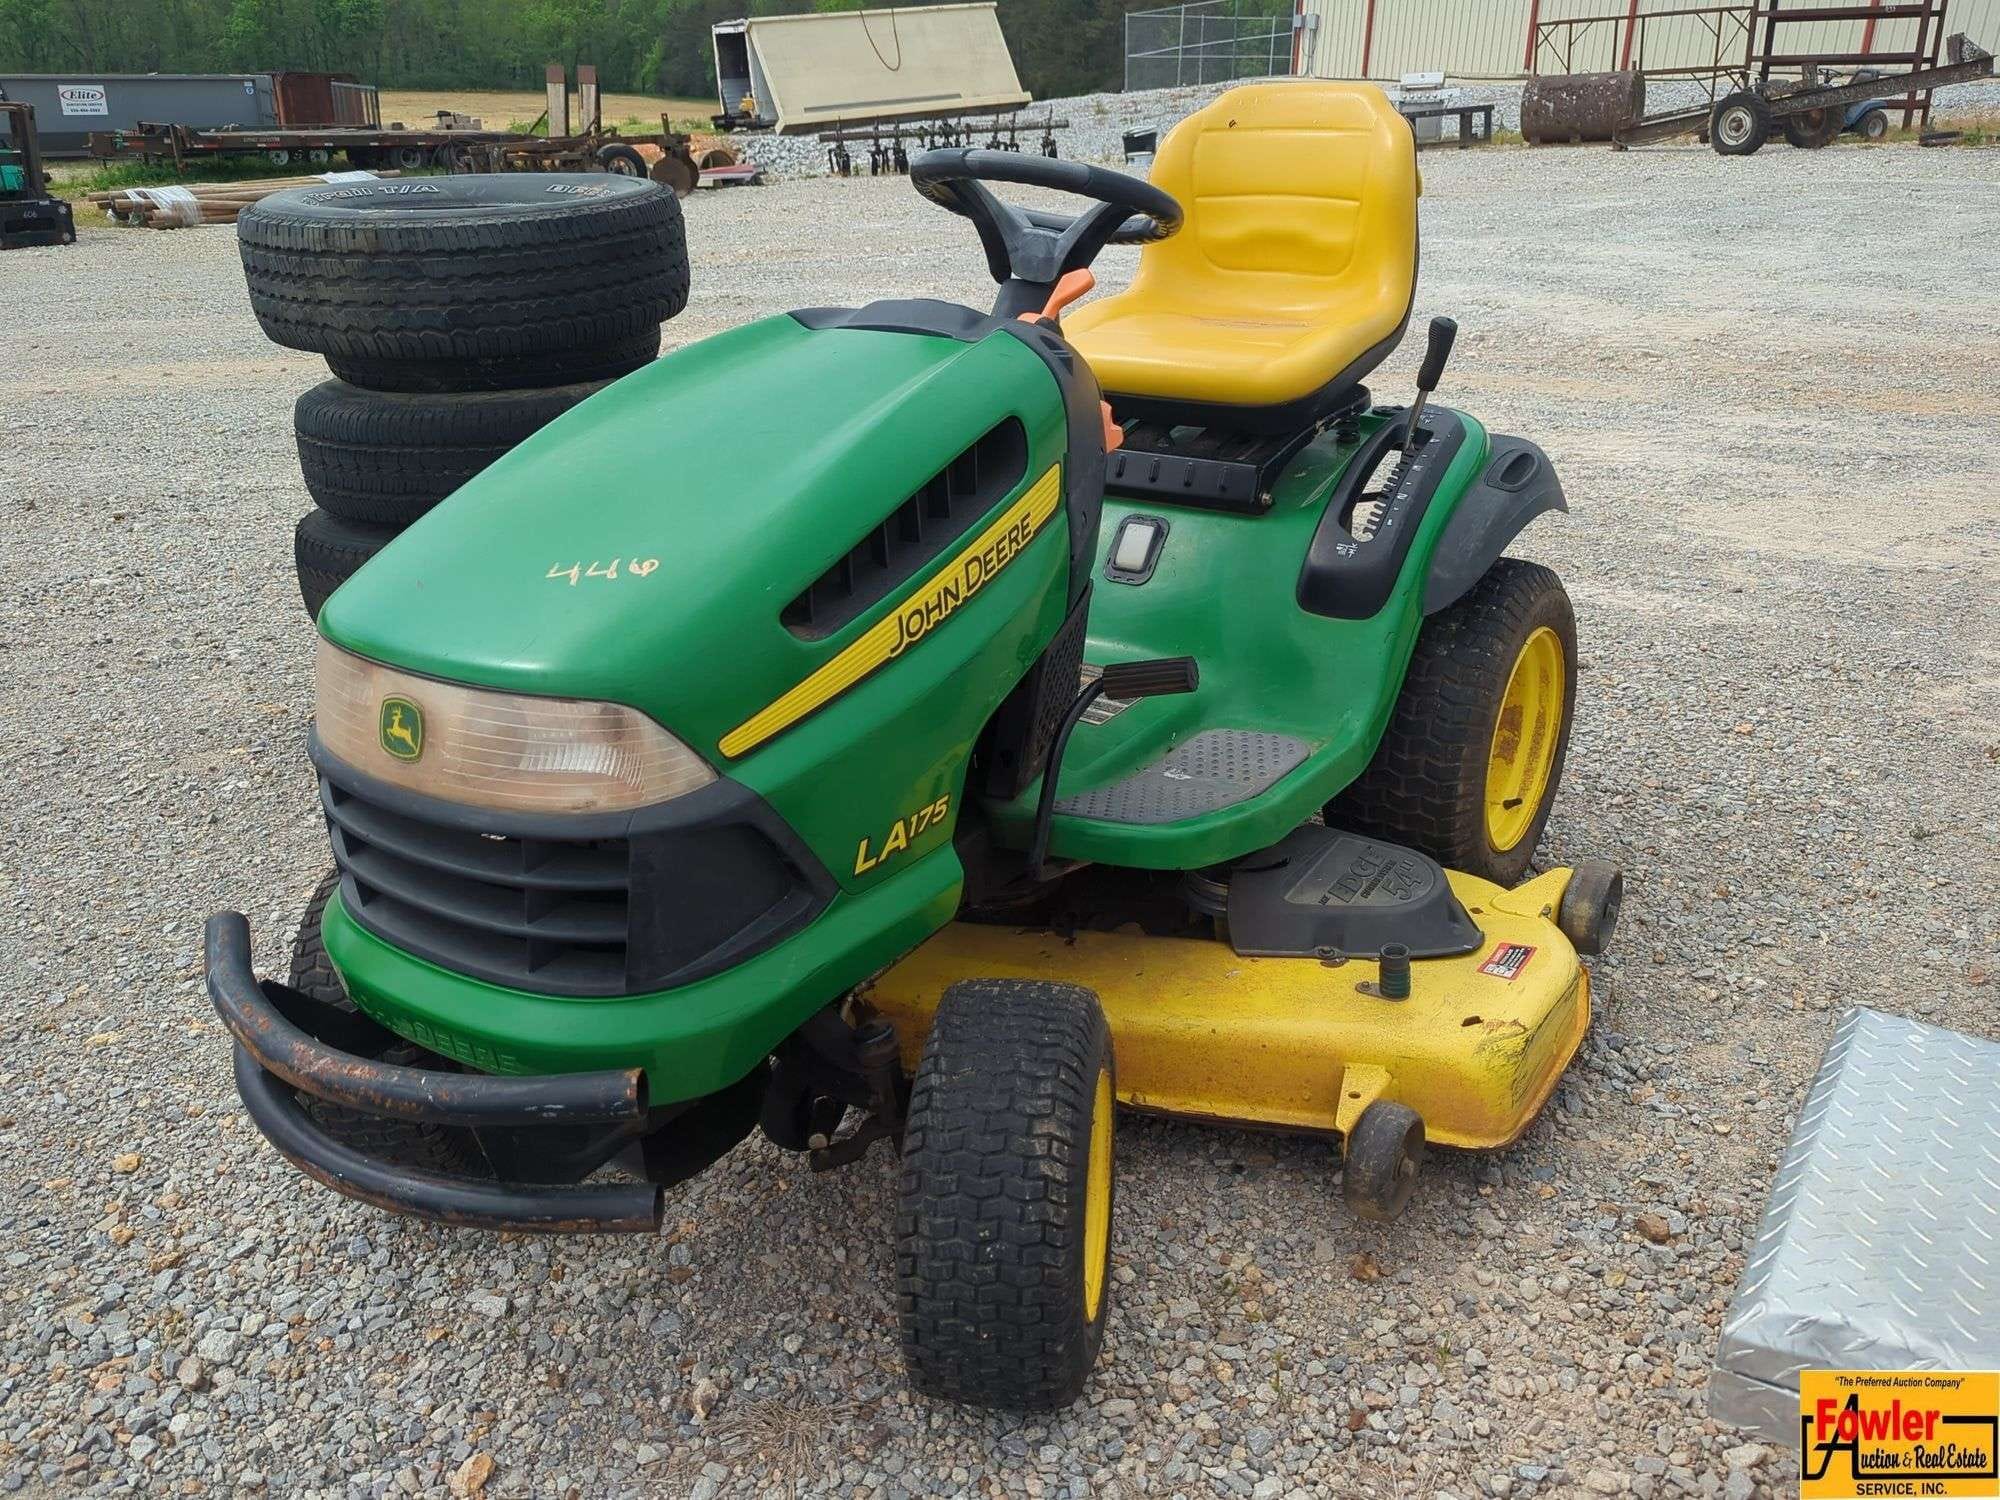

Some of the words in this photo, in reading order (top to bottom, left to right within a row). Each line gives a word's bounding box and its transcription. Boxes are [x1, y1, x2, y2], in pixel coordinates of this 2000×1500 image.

[70, 90, 97, 99] Elite
[890, 577, 961, 656] JOHN
[964, 512, 1033, 596] DEERE
